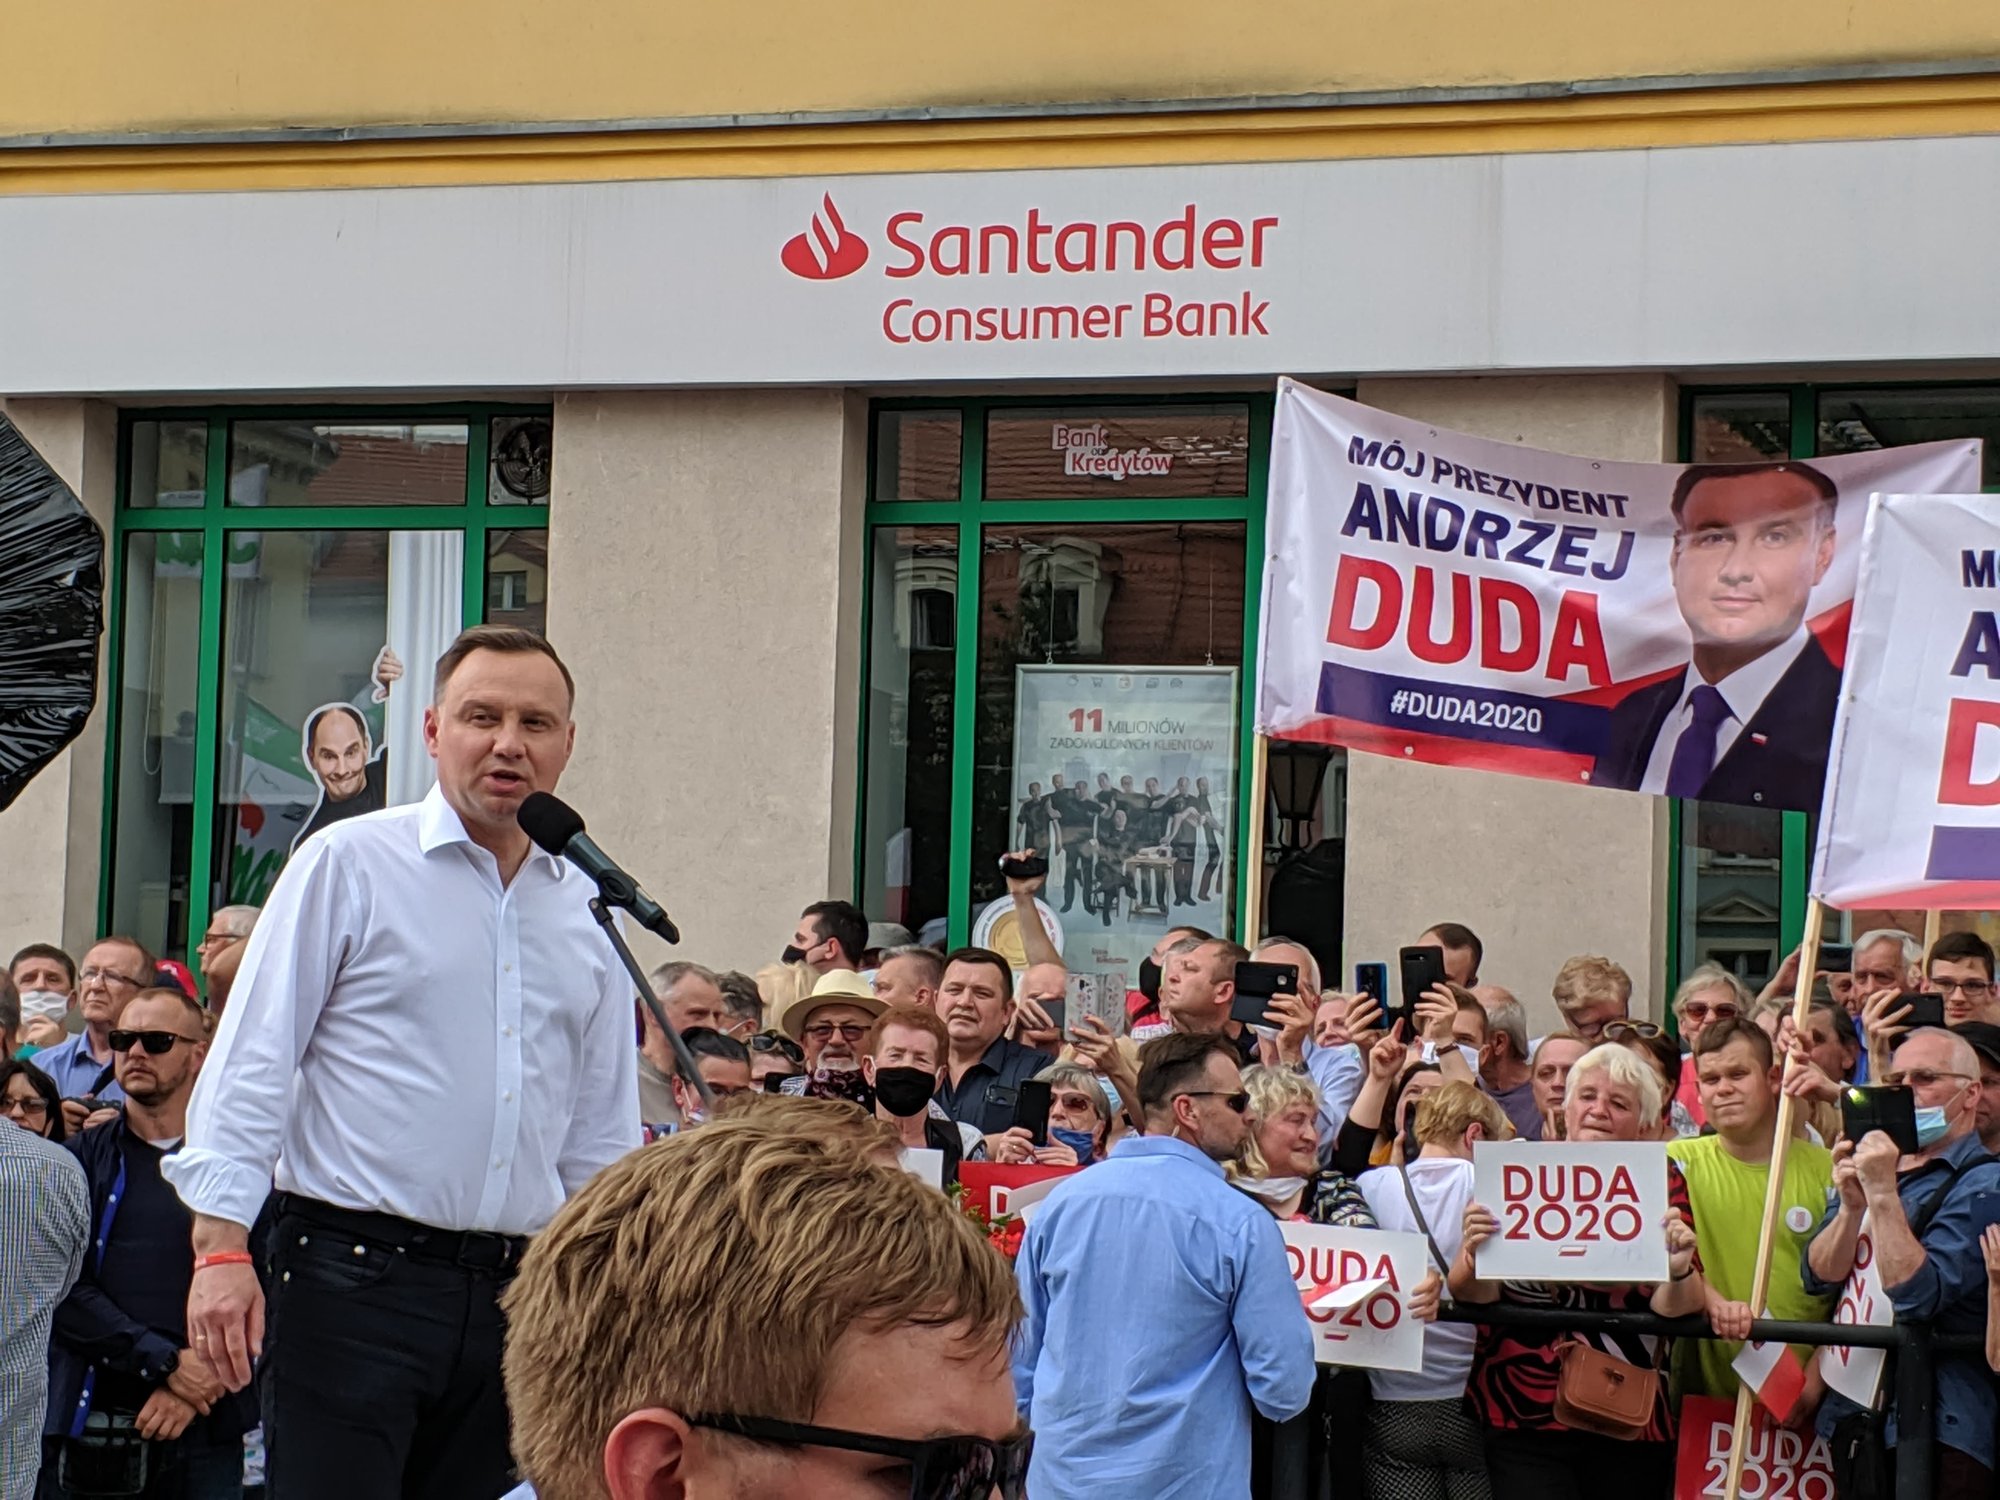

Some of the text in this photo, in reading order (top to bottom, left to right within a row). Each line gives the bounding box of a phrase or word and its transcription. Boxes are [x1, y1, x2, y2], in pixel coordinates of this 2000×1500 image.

[884, 203, 1279, 278] Santander
[883, 291, 1270, 343] Consumer Bank
[1056, 425, 1108, 448] Bank
[1347, 436, 1629, 518] MÓJ PREZYDENT
[1340, 481, 1635, 580] ANDRZEJ
[1326, 554, 1613, 686] DUDA
[1068, 708, 1185, 734] 11 MILIONÓW
[1390, 690, 1542, 733] #DUDA2020
[1154, 737, 1215, 750] KLIENTÓW
[1503, 1165, 1640, 1203] DUDA
[1504, 1203, 1642, 1241] 2020
[1709, 1421, 1834, 1472] DUDA
[1702, 1458, 1835, 1500] 2020
